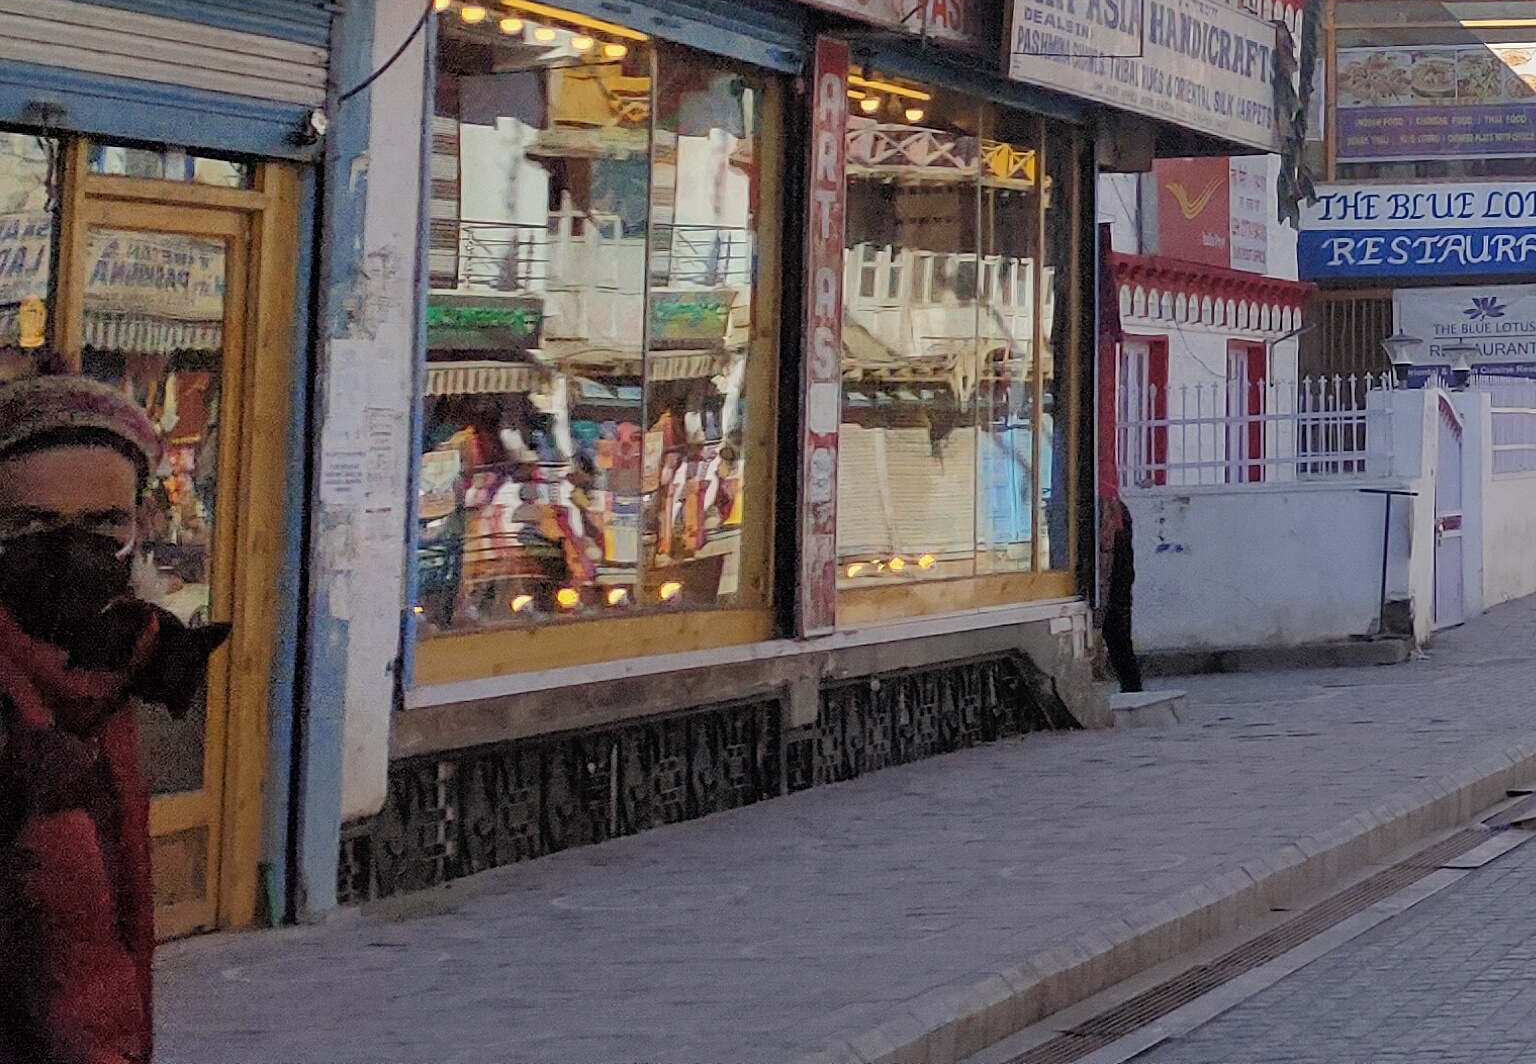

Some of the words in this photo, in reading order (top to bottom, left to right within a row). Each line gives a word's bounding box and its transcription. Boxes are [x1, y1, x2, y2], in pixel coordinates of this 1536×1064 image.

[1148, 1, 1279, 86] HANDICRAFTS
[1316, 190, 1382, 222] THE
[1386, 190, 1476, 221] BLUE
[1433, 323, 1457, 336] THE
[1461, 322, 1492, 335] BLUE
[1495, 320, 1536, 333] LOTUS
